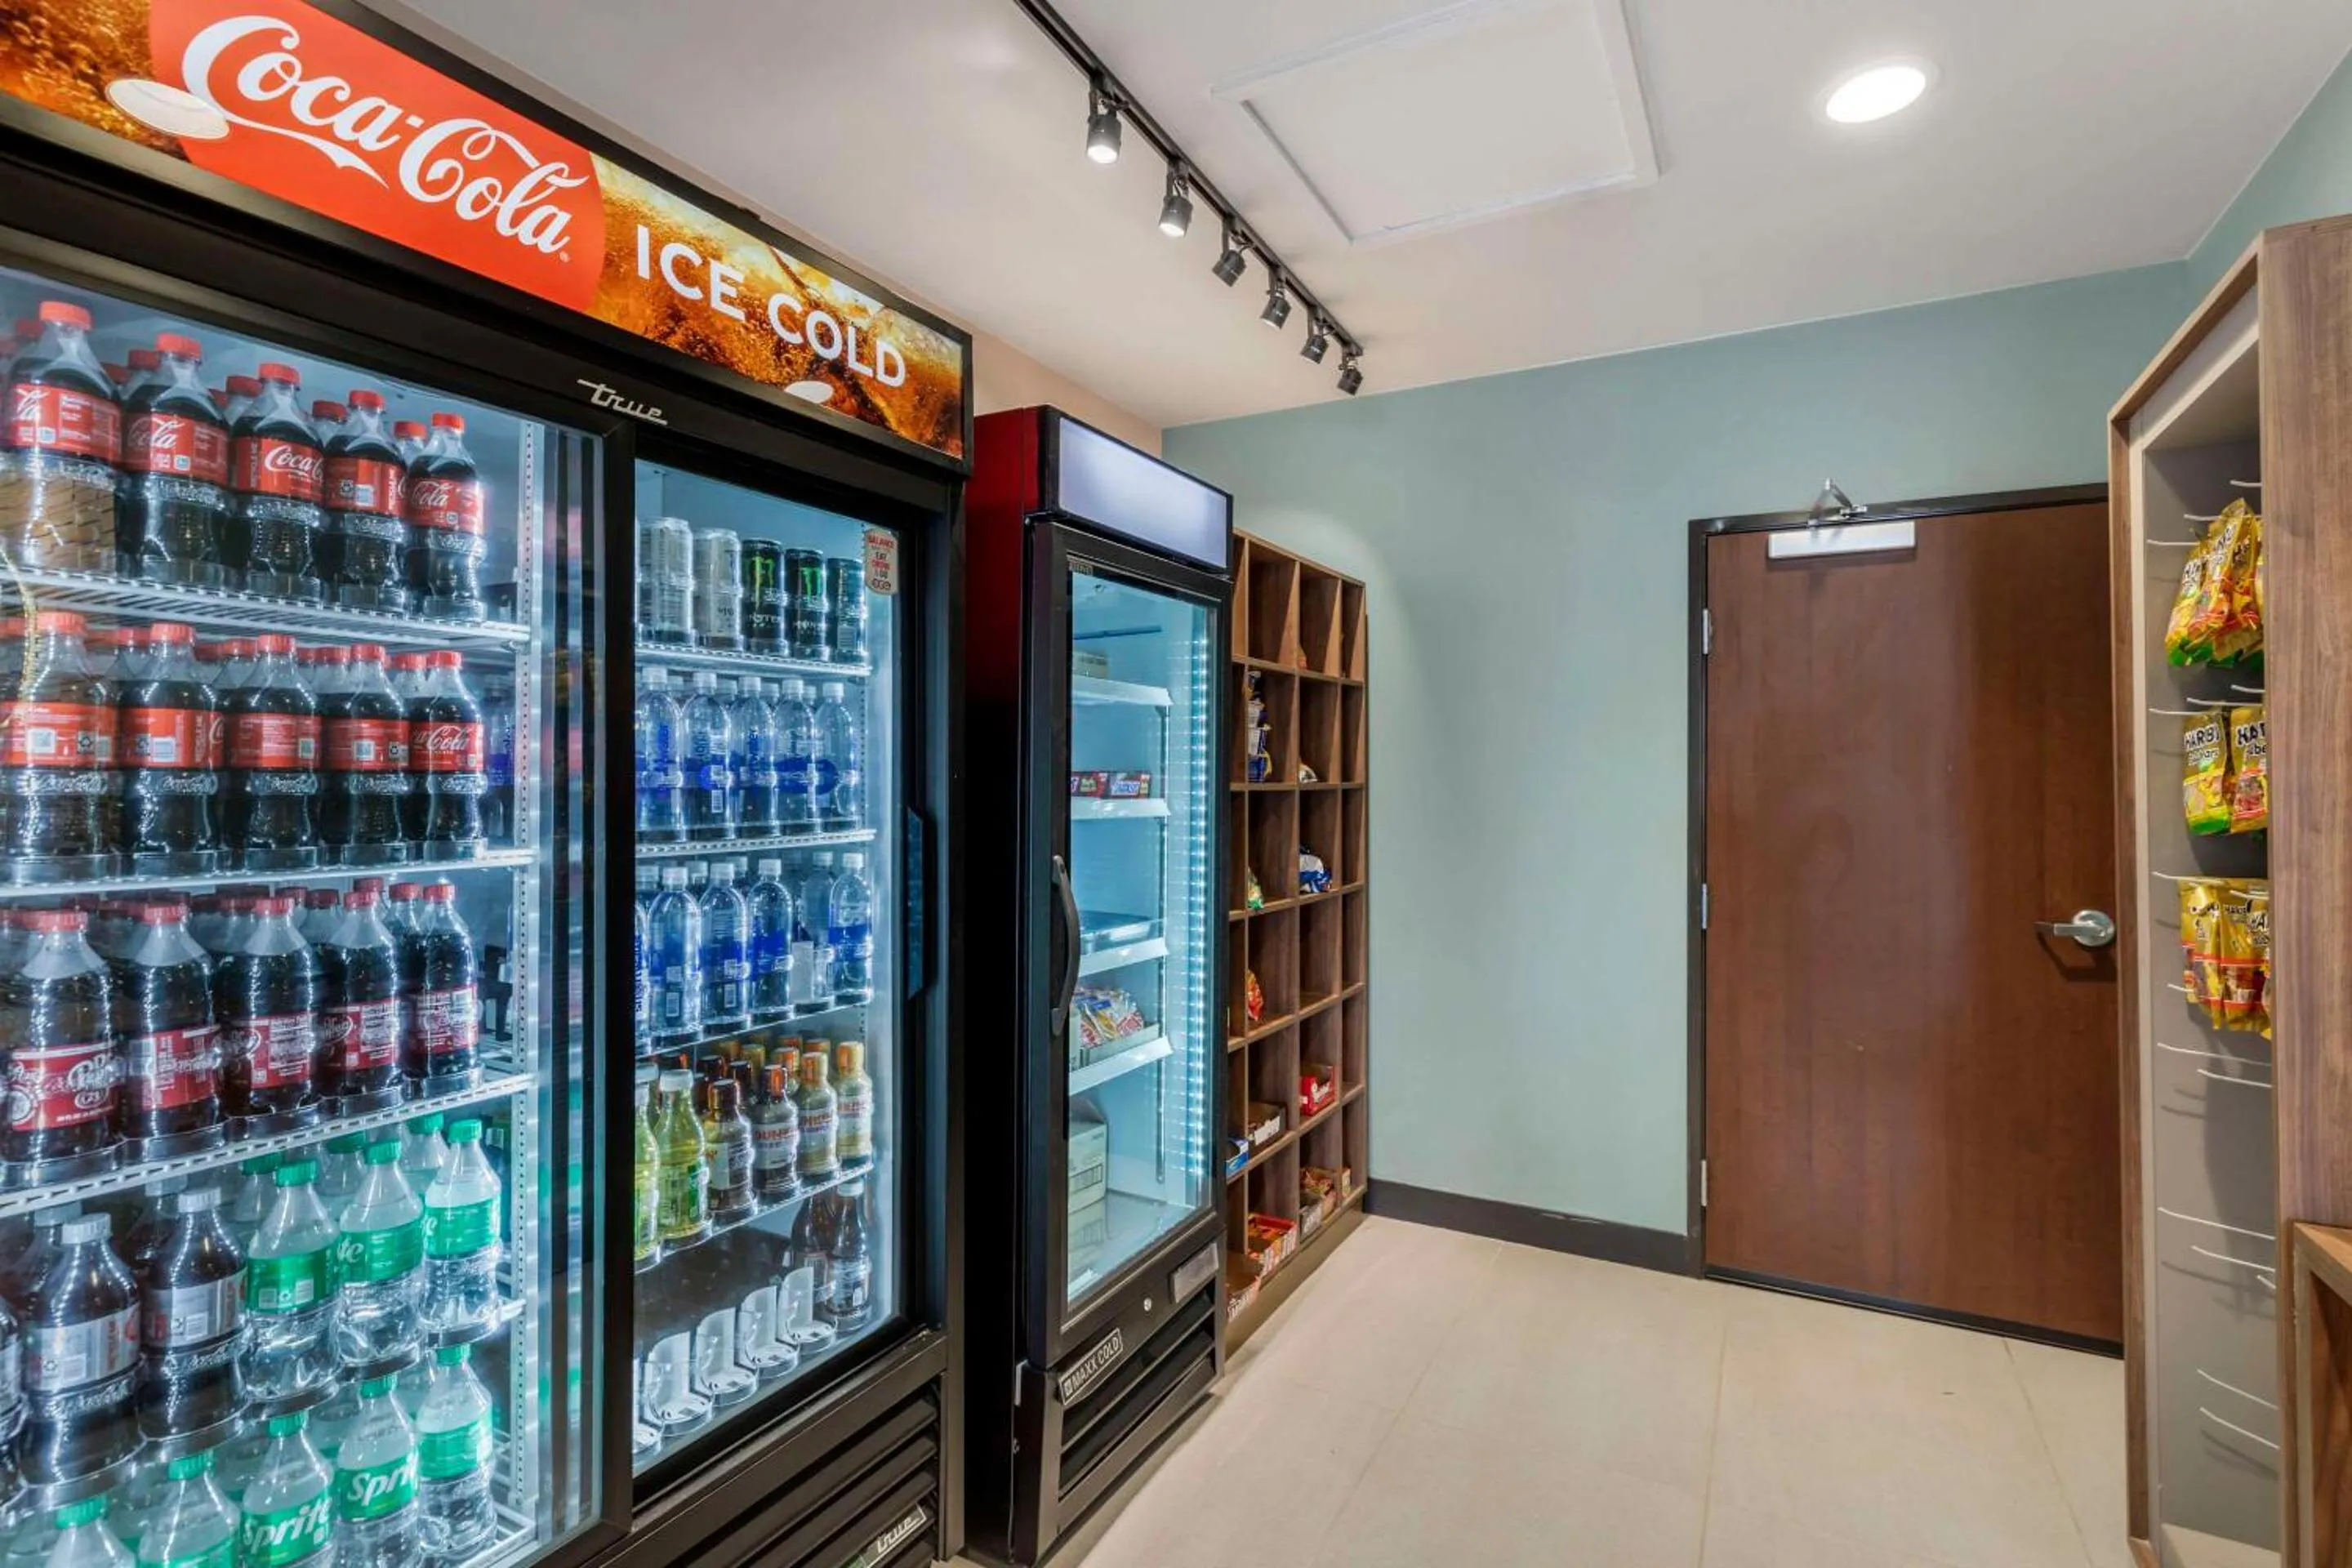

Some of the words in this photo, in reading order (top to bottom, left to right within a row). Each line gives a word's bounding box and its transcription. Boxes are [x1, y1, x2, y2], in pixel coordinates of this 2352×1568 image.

[182, 15, 589, 255] Coca-Cola
[636, 224, 746, 322] ICE
[767, 292, 906, 388] COLD
[577, 378, 669, 426] true
[1071, 1355, 1098, 1392] MAXX
[1097, 1336, 1119, 1365] COLD
